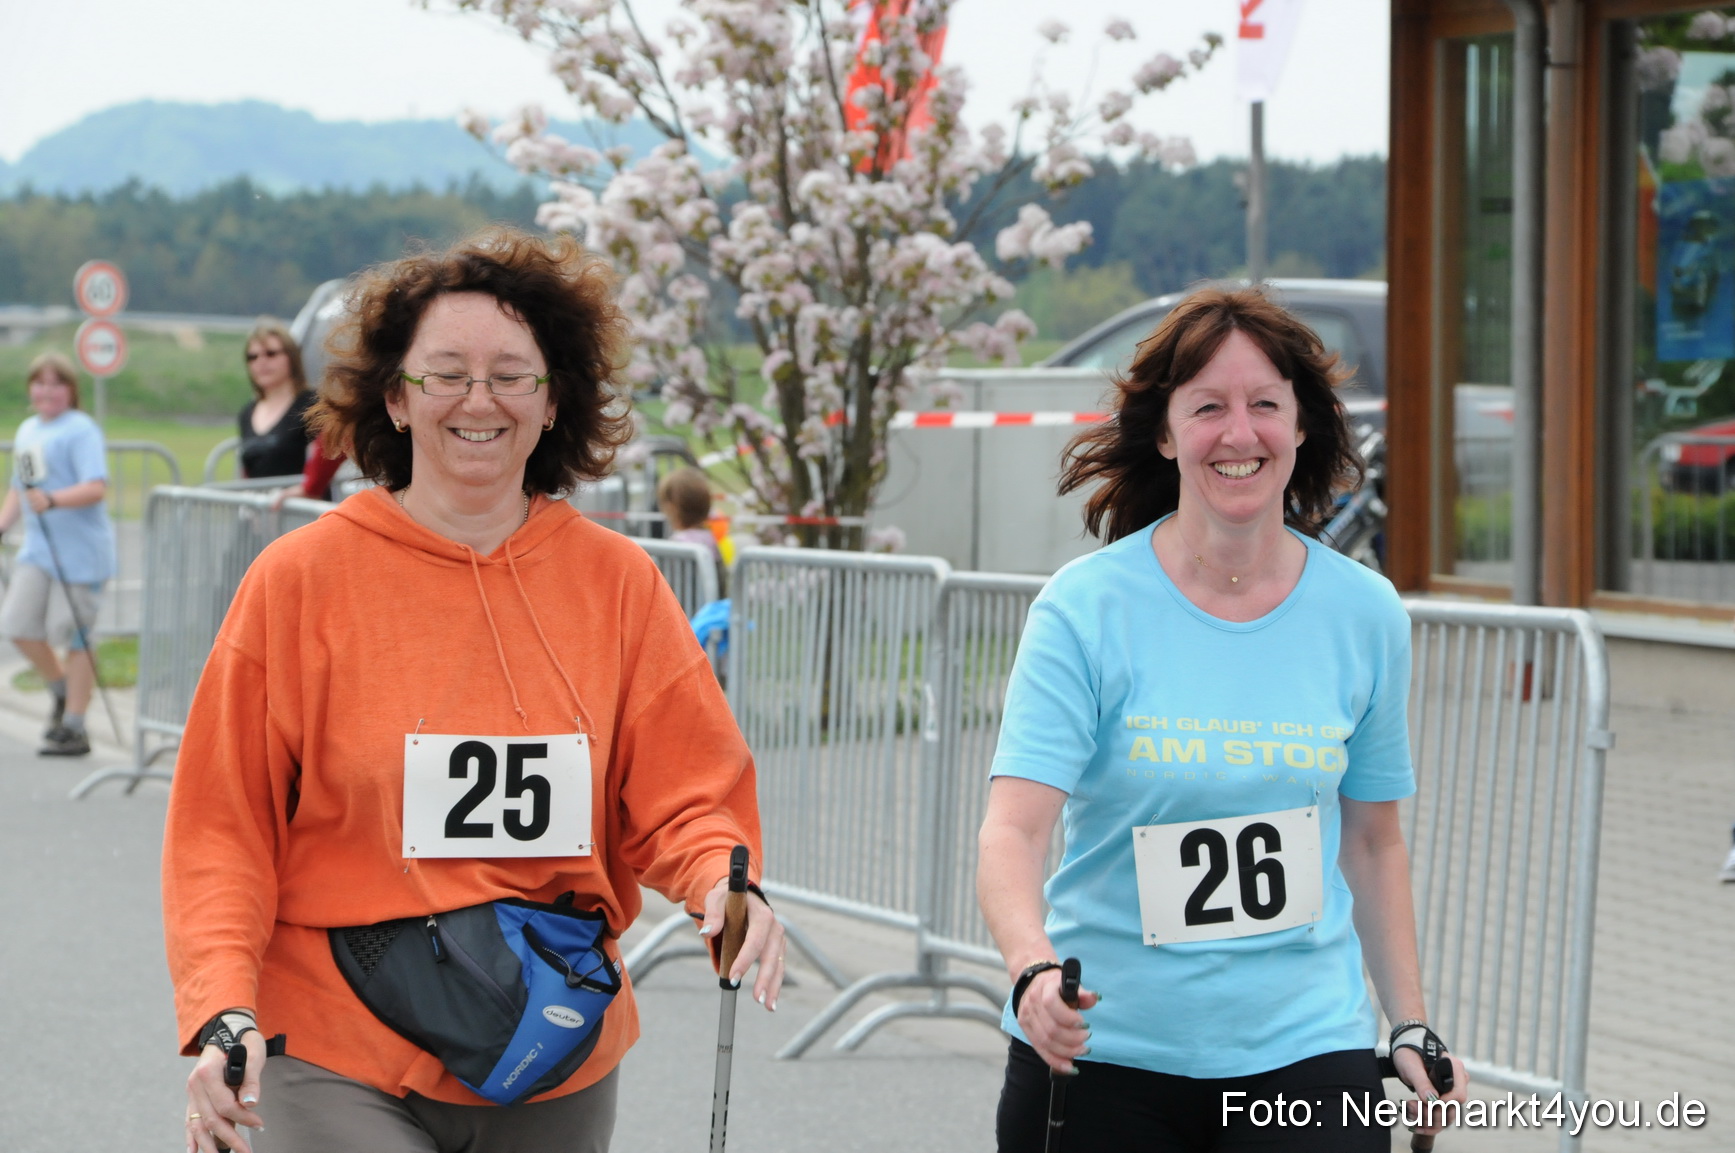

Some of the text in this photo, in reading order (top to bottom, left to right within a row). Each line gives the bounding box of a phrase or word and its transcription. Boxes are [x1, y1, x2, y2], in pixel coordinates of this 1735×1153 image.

[1125, 715, 1169, 730] ICH
[1175, 717, 1263, 735] GLAUB'
[1271, 721, 1314, 738] ICH
[1127, 735, 1207, 764] AM
[1125, 767, 1228, 781] NORDIC
[444, 740, 552, 842] 25
[1179, 821, 1287, 927] 26
[545, 1009, 582, 1024] deuter
[502, 1048, 538, 1090] NORDIC
